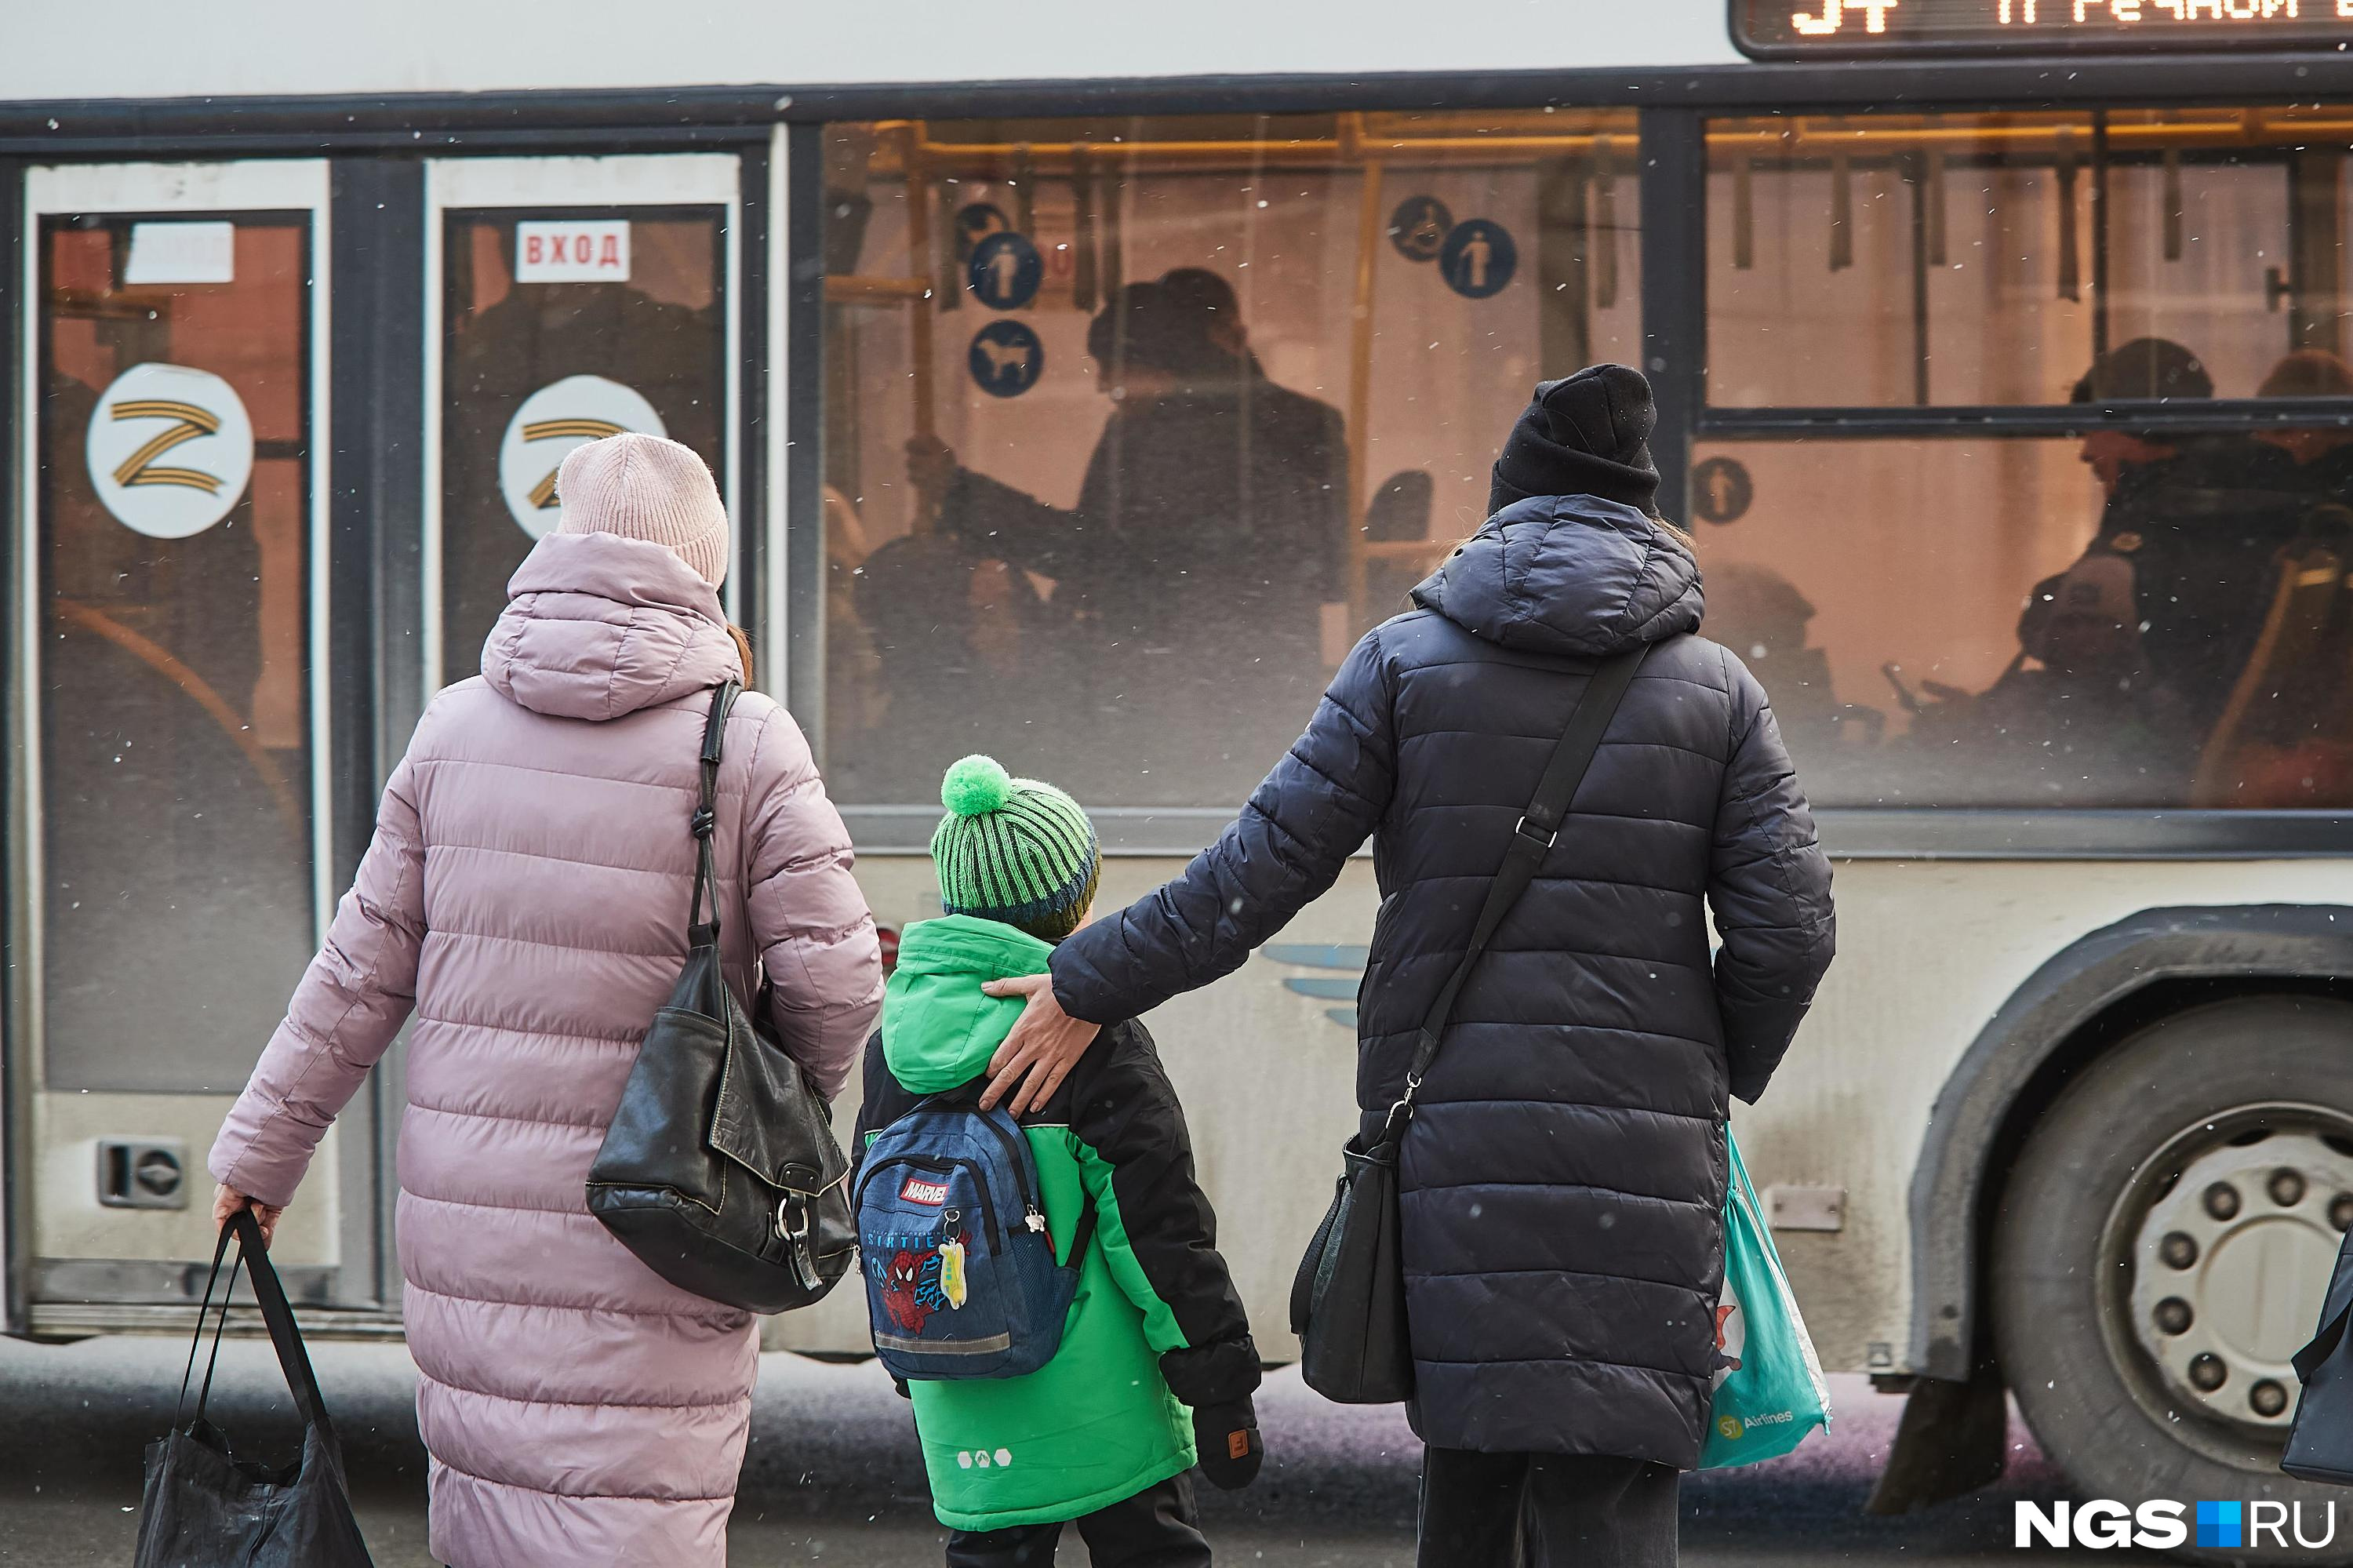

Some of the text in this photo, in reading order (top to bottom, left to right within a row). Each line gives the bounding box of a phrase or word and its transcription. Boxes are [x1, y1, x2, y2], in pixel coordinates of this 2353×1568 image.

[526, 235, 620, 266] ВХОД
[904, 1181, 947, 1202] MARVEL
[1721, 1410, 1794, 1436] S7 Airlines
